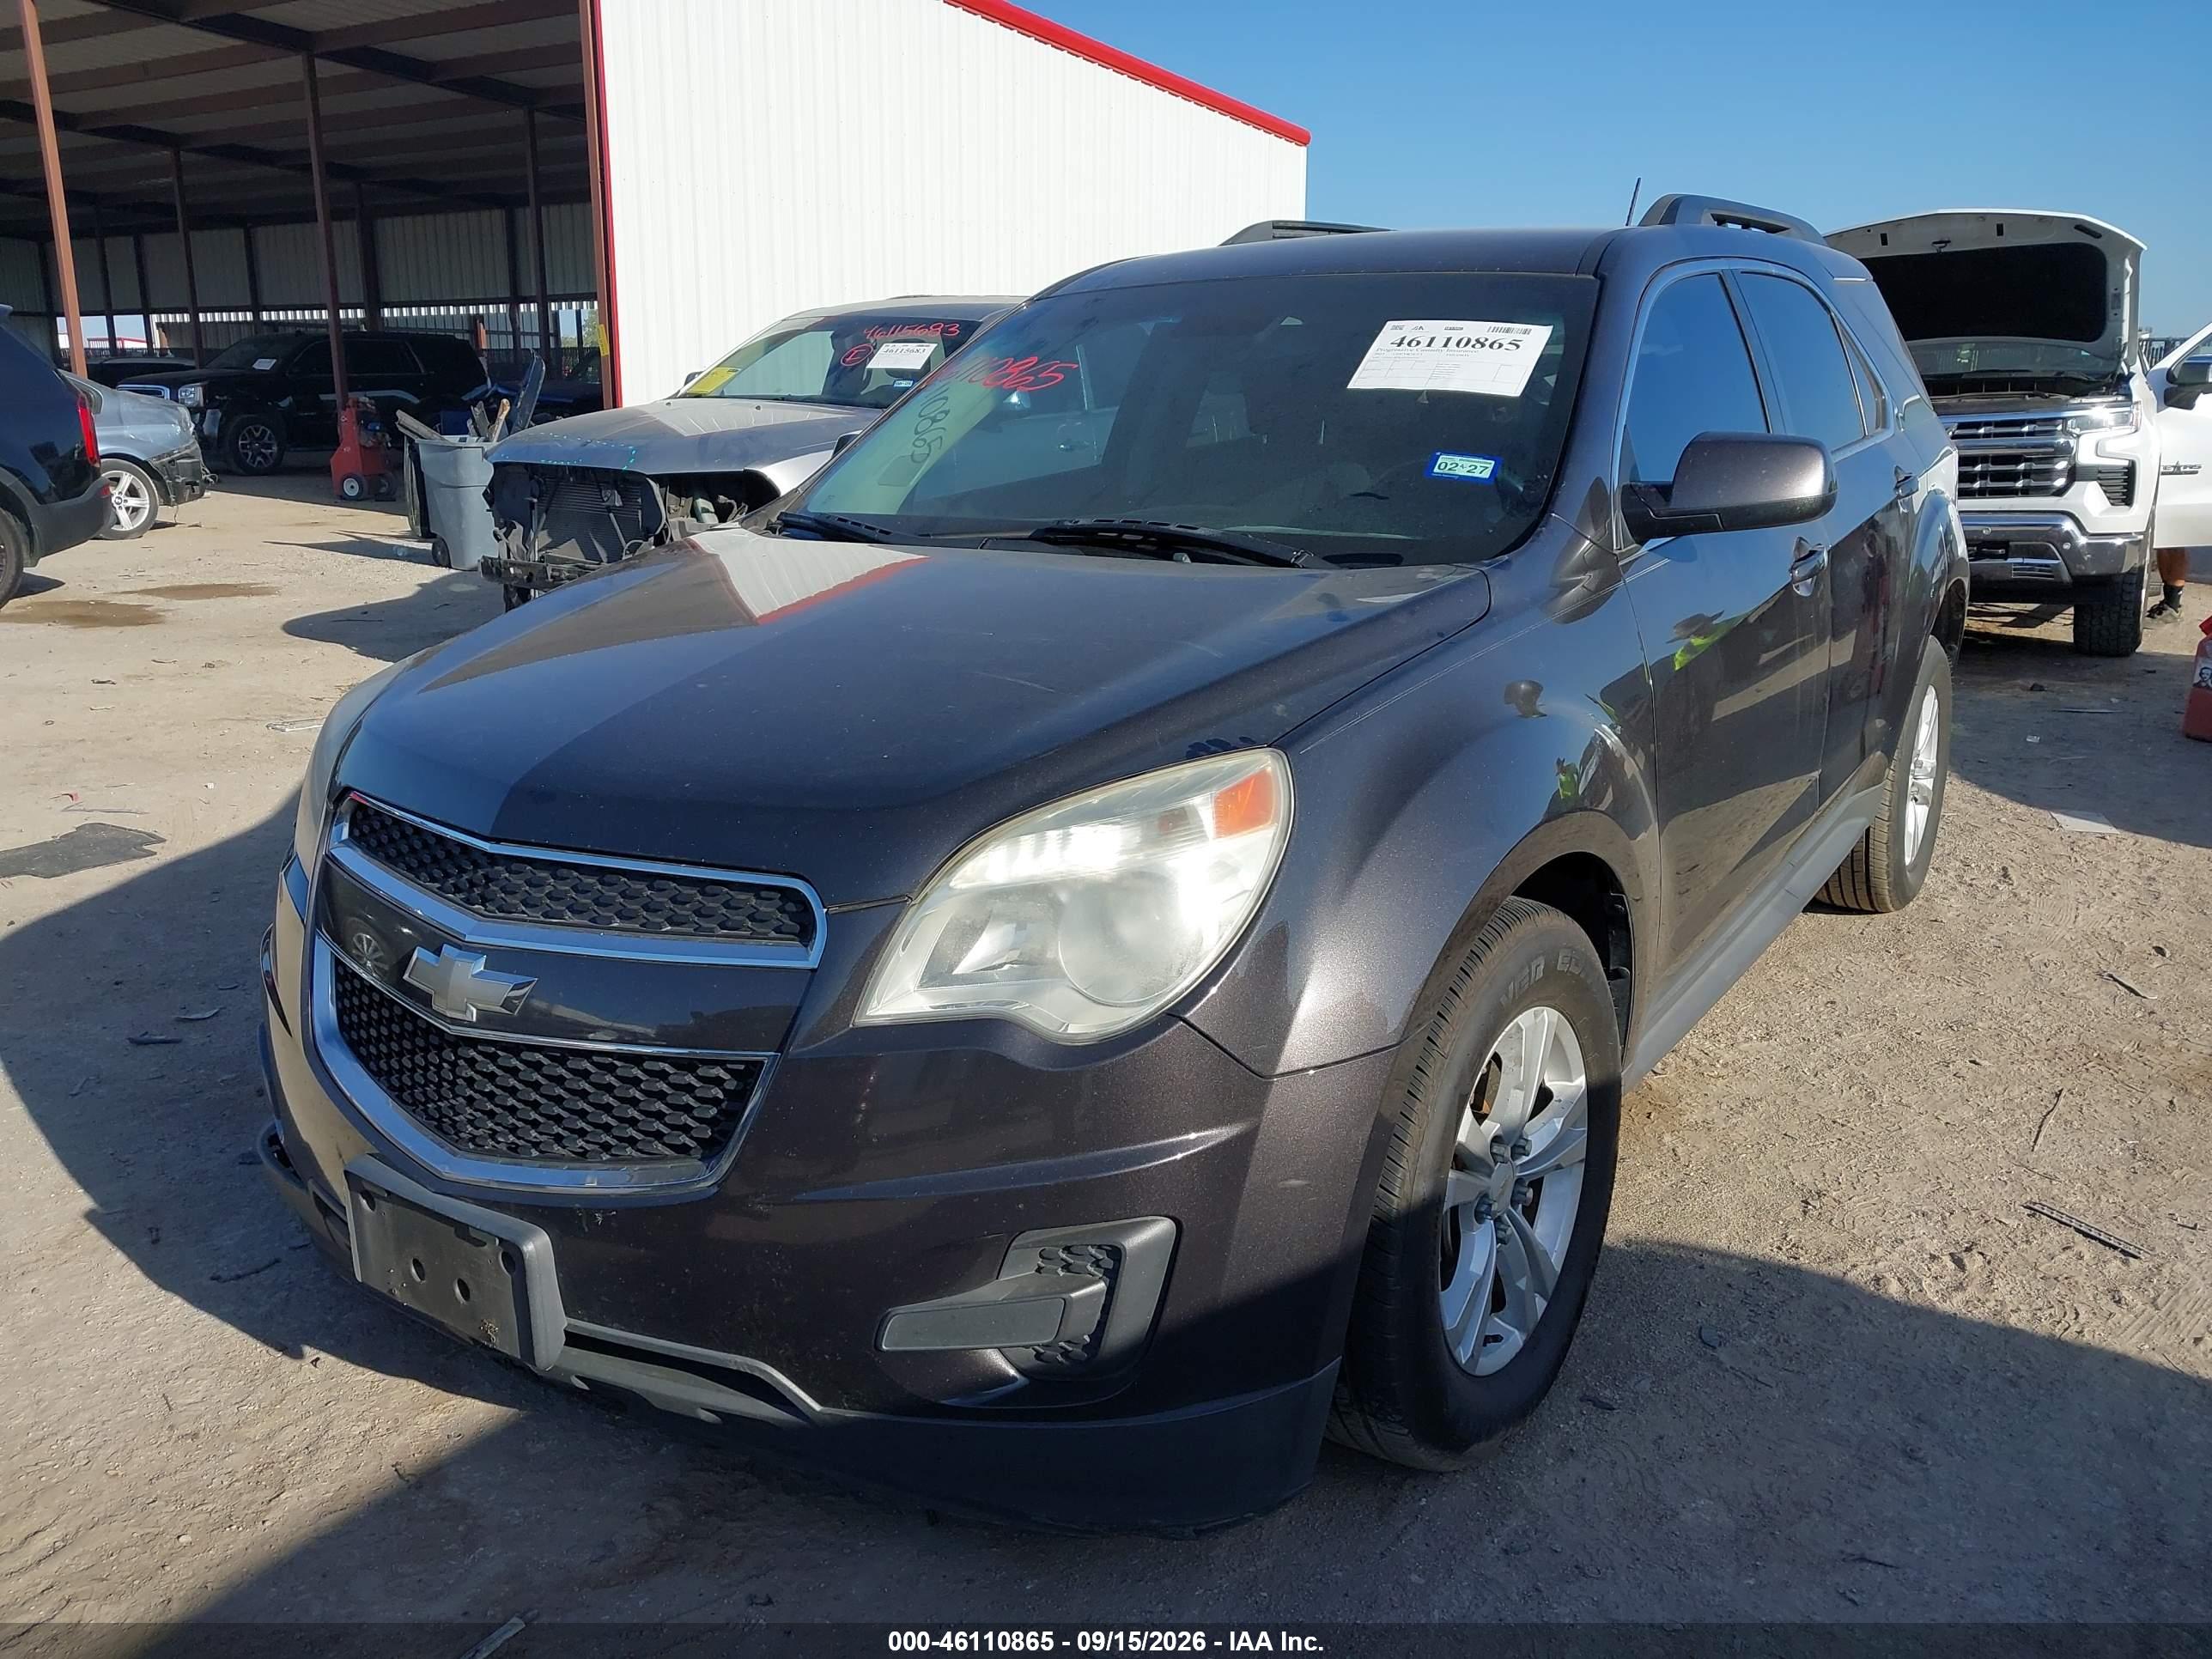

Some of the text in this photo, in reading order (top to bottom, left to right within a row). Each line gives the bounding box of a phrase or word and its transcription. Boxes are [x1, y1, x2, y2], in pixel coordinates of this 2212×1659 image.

[1390, 336, 1524, 351] 46110865
[1437, 461, 1489, 475] 02 27
